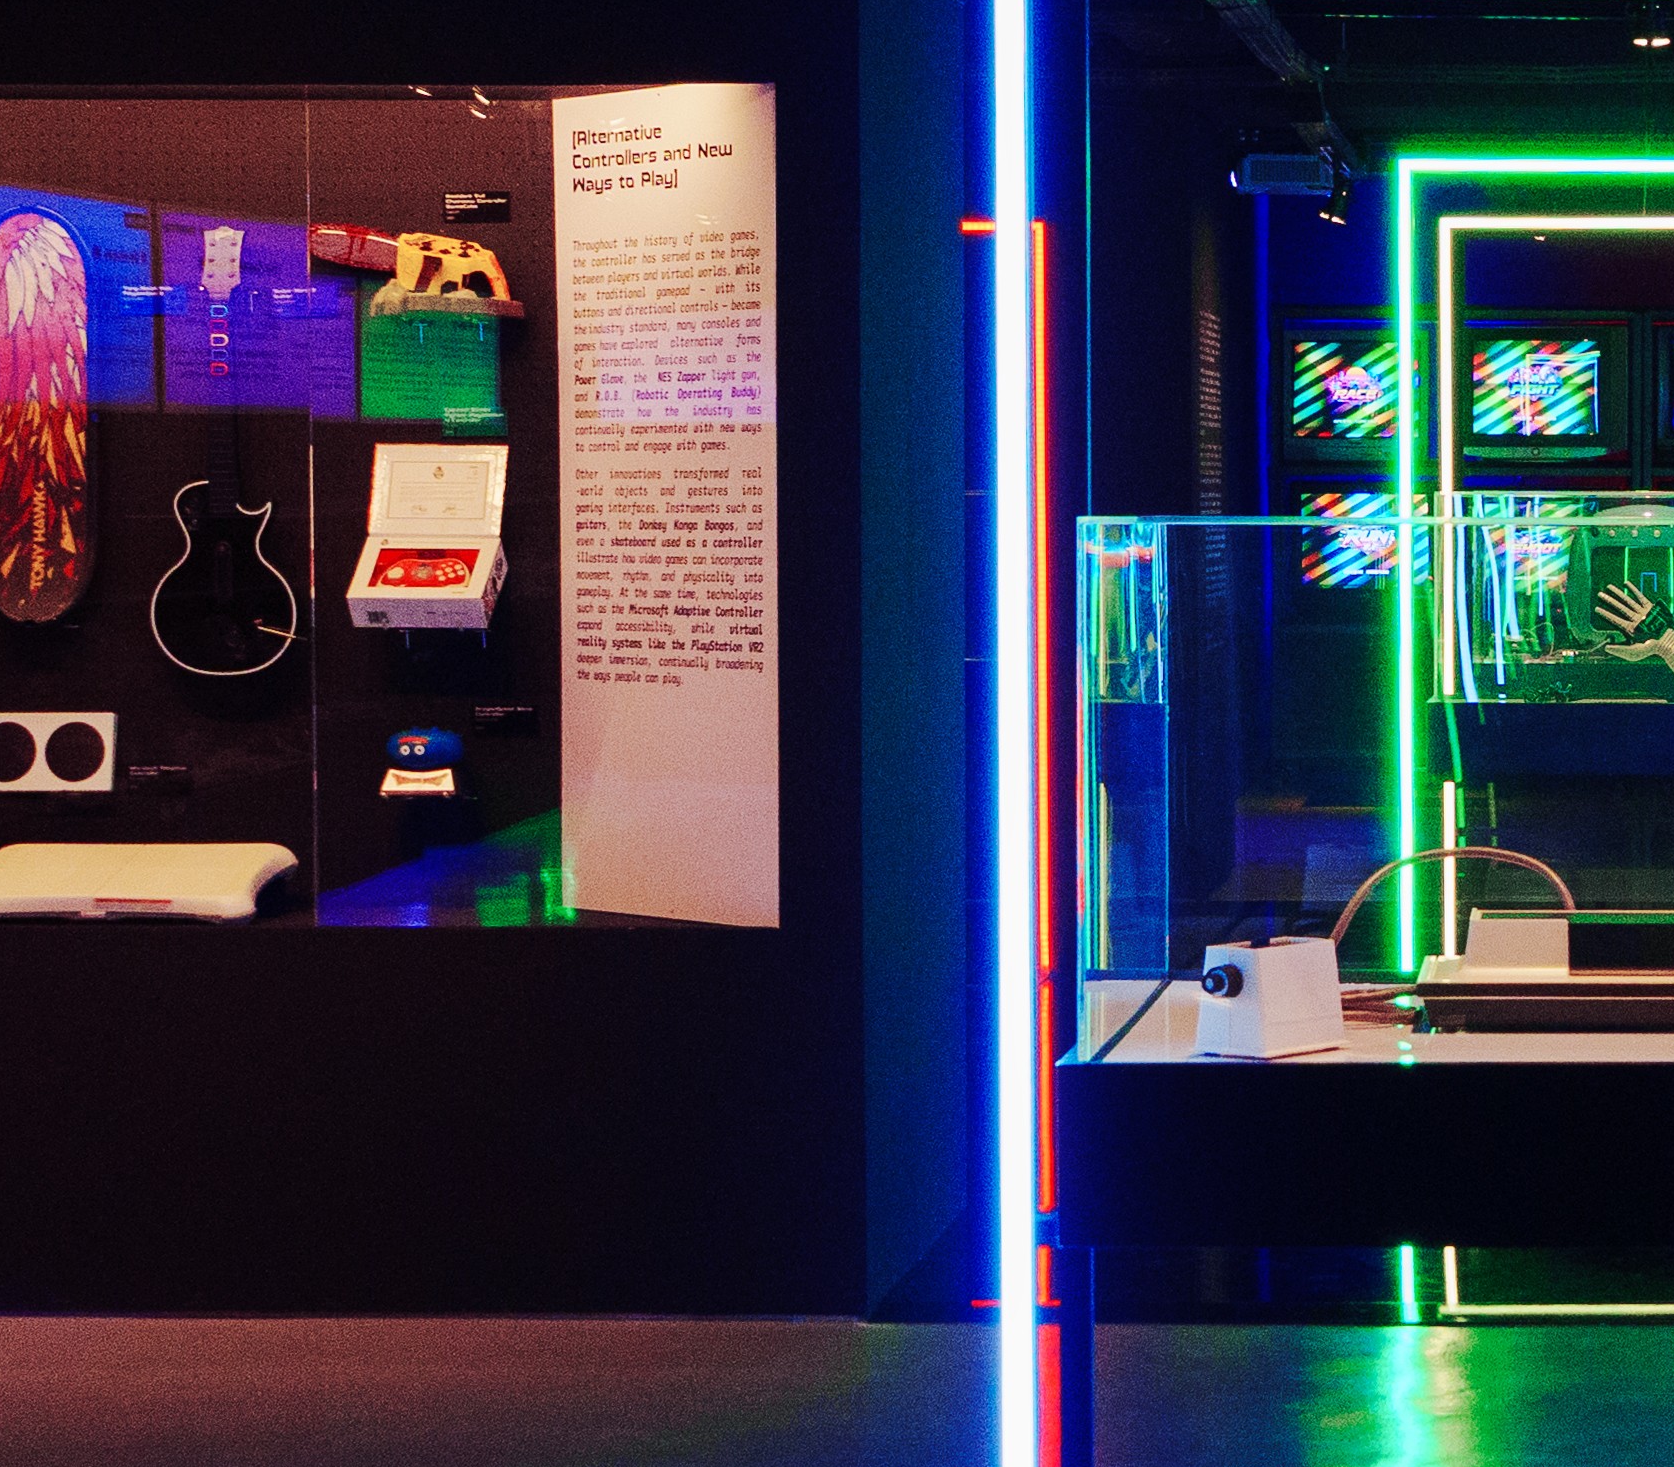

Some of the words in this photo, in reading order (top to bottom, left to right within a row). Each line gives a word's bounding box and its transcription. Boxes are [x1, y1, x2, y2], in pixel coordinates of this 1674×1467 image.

[572, 125, 662, 150] [Alternative
[572, 148, 657, 169] Controllers
[663, 145, 691, 162] and
[698, 143, 733, 158] New
[573, 175, 612, 195] Ways
[619, 175, 634, 188] to
[641, 169, 678, 190] Play]
[624, 238, 638, 247] the
[683, 233, 693, 245] of
[699, 232, 724, 242] video
[573, 258, 586, 268] the
[641, 254, 656, 264] has
[695, 252, 705, 260] as
[710, 249, 725, 259] the
[575, 442, 585, 452] to
[624, 441, 639, 451] and
[676, 440, 697, 450] with
[32, 488, 47, 542] HAWK
[725, 503, 747, 513] such
[29, 544, 46, 591] TONY
[576, 604, 594, 613] such
[611, 604, 625, 614] the
[648, 639, 666, 649] like
[671, 640, 685, 650] the
[748, 642, 764, 652] VR2
